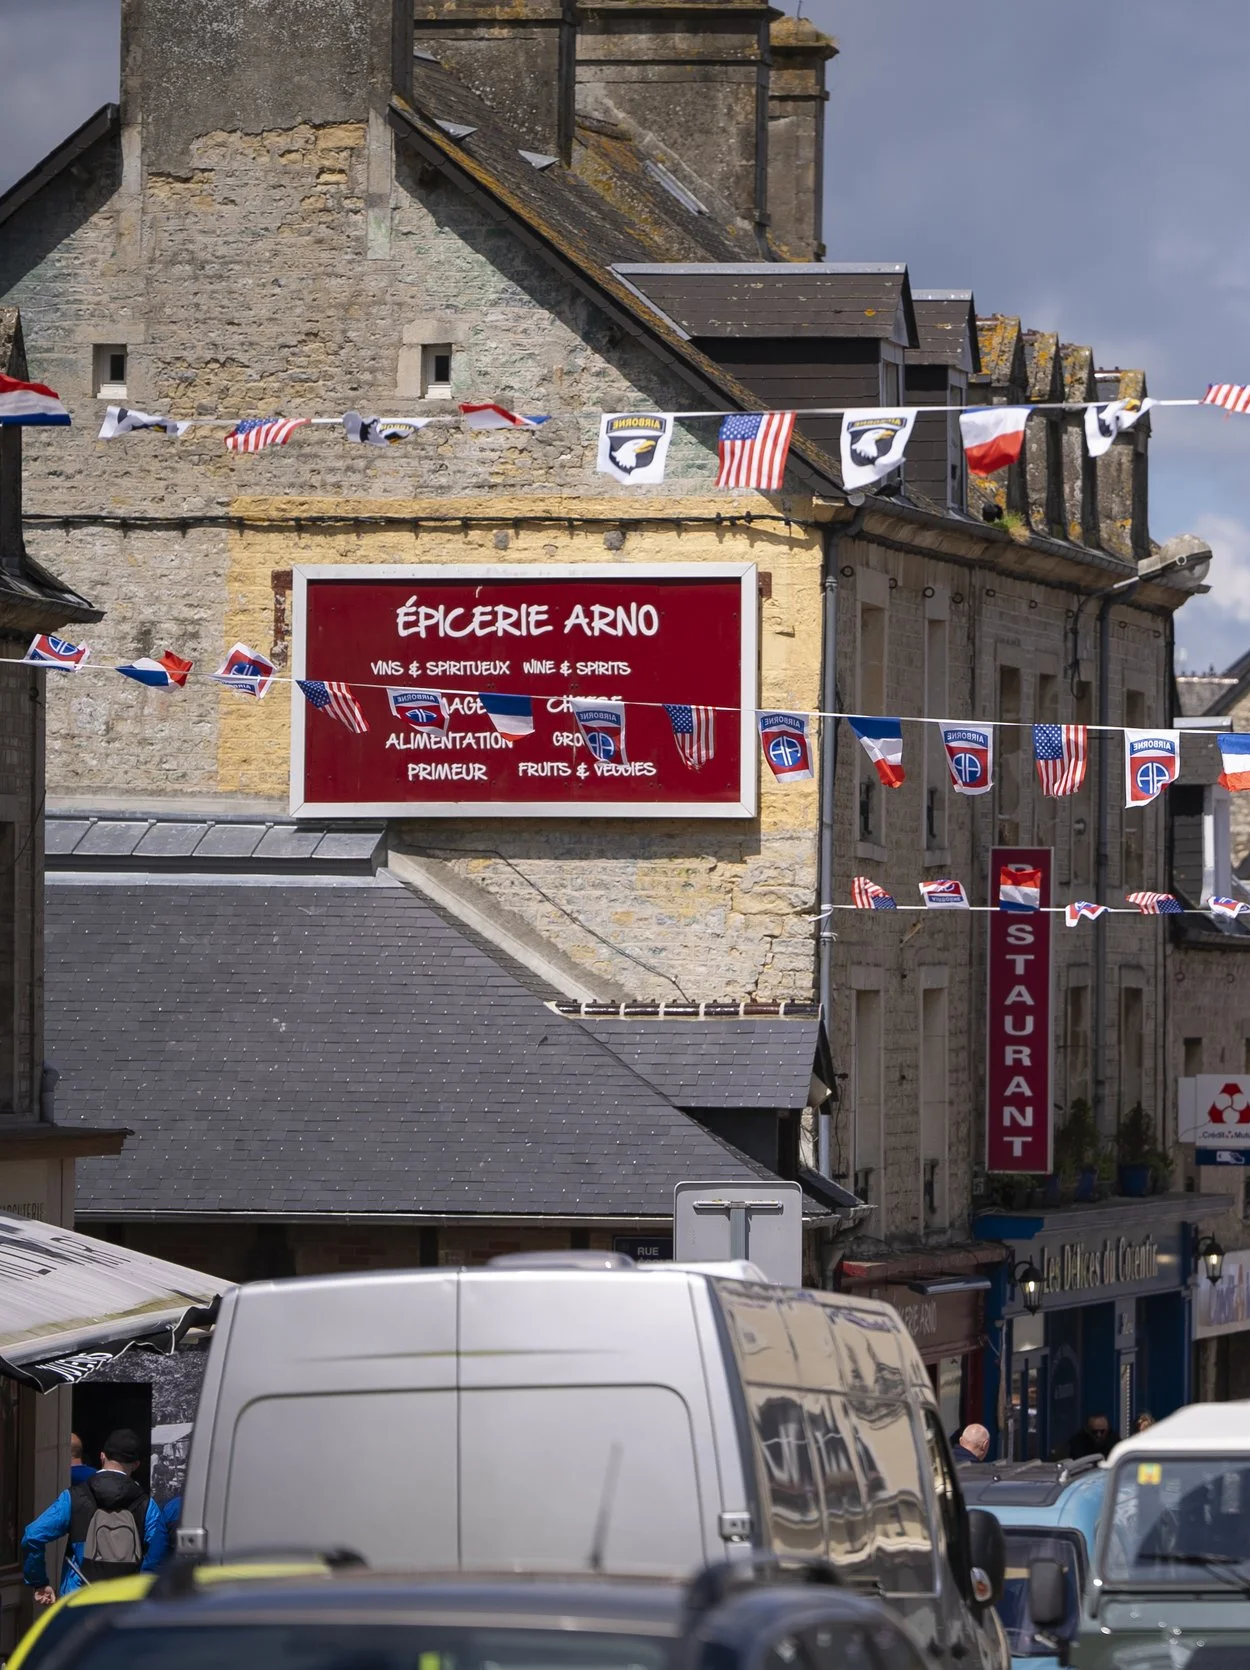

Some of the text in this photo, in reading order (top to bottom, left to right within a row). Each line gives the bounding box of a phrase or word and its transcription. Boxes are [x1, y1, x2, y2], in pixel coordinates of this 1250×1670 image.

[396, 595, 659, 638] ÉPICERIE ARNO
[371, 659, 631, 678] VINS & SPIRITUEUX WINE & SPIRITS
[408, 763, 488, 781] PRIMEUR
[519, 762, 572, 777] FRUITS
[576, 762, 589, 779] &
[1202, 1130, 1225, 1139] Crédit
[637, 1246, 659, 1256] RUE
[1043, 1247, 1060, 1294] Les
[1064, 1242, 1101, 1291] Délices
[1103, 1240, 1116, 1285] du
